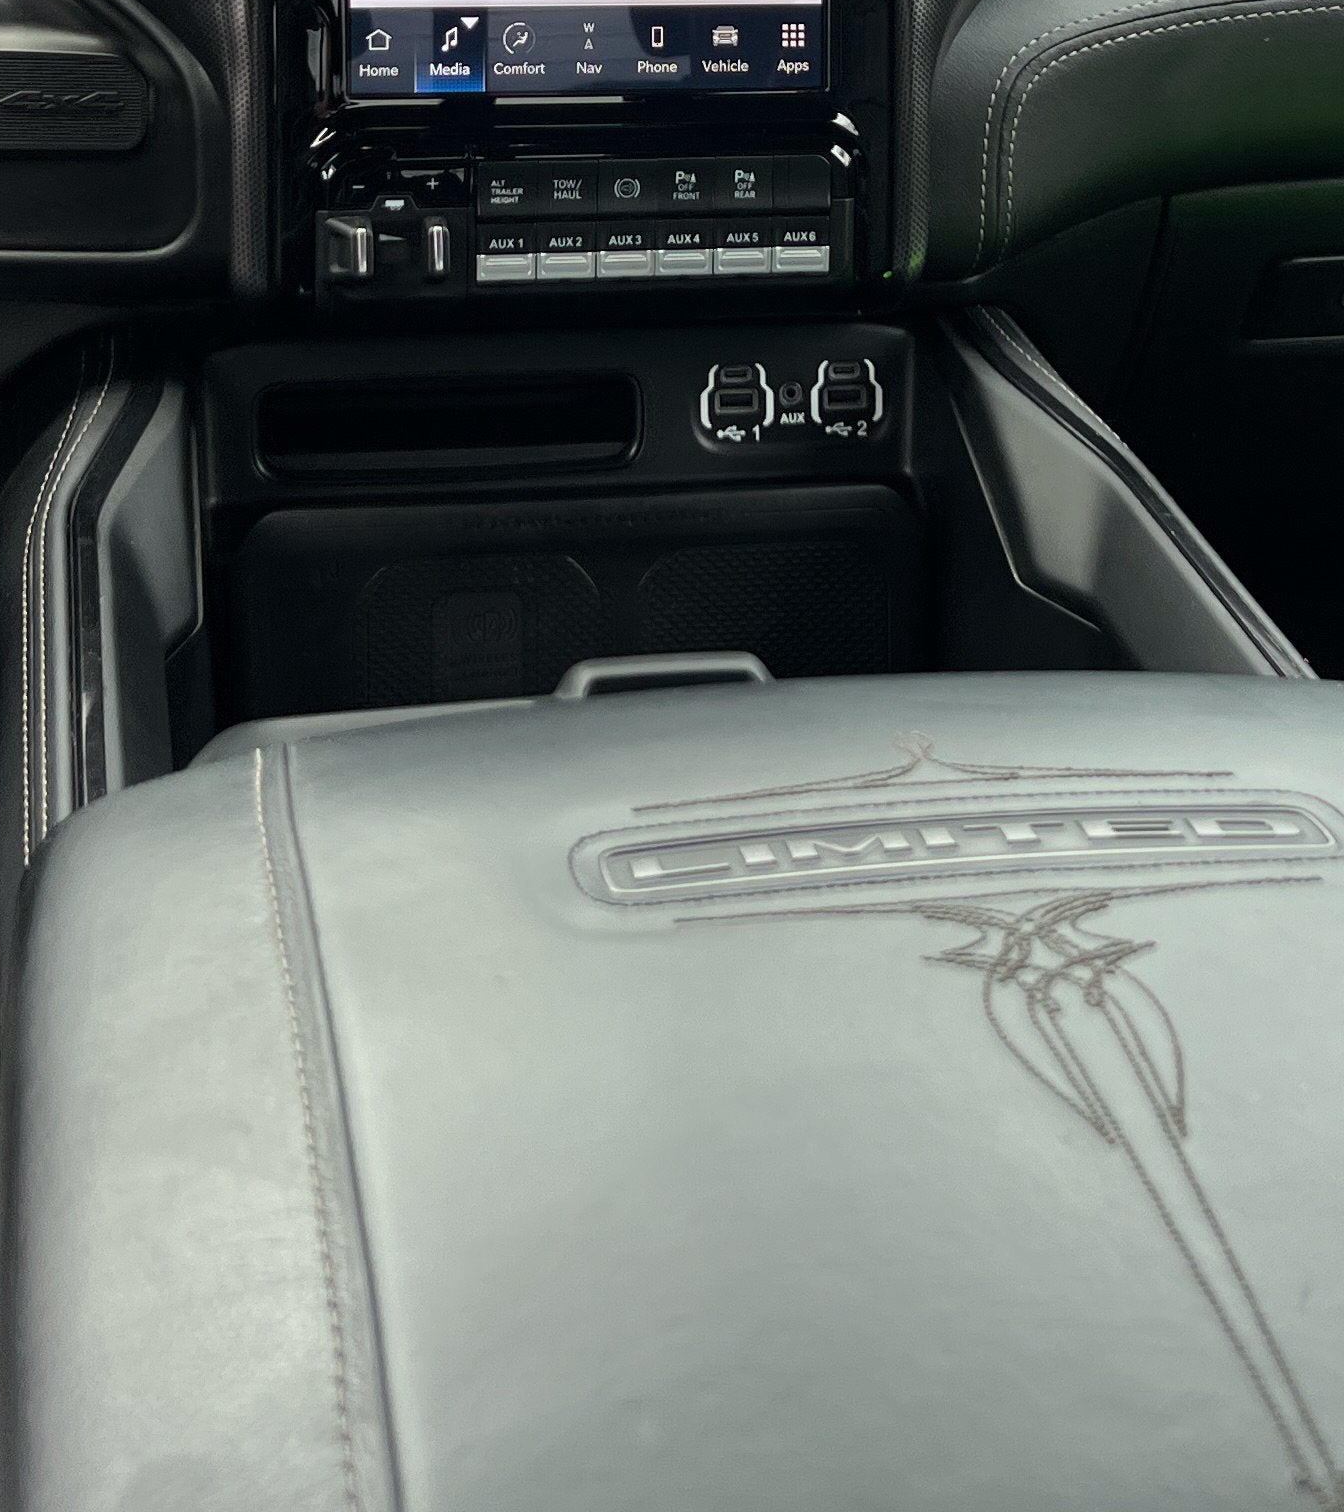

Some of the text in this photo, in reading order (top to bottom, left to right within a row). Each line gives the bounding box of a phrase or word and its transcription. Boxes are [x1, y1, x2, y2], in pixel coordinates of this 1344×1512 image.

[358, 63, 400, 78] Home
[429, 63, 471, 77] Media
[493, 61, 547, 76] Comfort
[576, 61, 603, 75] Nav
[636, 60, 678, 74] Phone
[701, 59, 750, 73] Vehicle
[776, 59, 810, 76] Apps
[490, 179, 506, 187] ALT
[553, 179, 583, 189] TOW/
[677, 183, 694, 192] OFF
[737, 182, 753, 190] OFF
[491, 187, 524, 196] TRAILER
[553, 189, 583, 200] HAUL
[672, 191, 700, 200] FRONT
[734, 190, 756, 199] REAR
[490, 196, 519, 205] HEIGHT
[549, 236, 583, 248] AUX 2
[608, 235, 642, 246] AUX 3
[667, 233, 701, 244] AUX 4
[726, 232, 759, 243] AUX 5
[783, 231, 817, 242] AUX 6
[489, 238, 524, 249] AUX 1
[779, 412, 806, 425] AUX
[752, 424, 761, 442] 1
[856, 420, 868, 437] 2
[629, 815, 1302, 880] LIMITED
